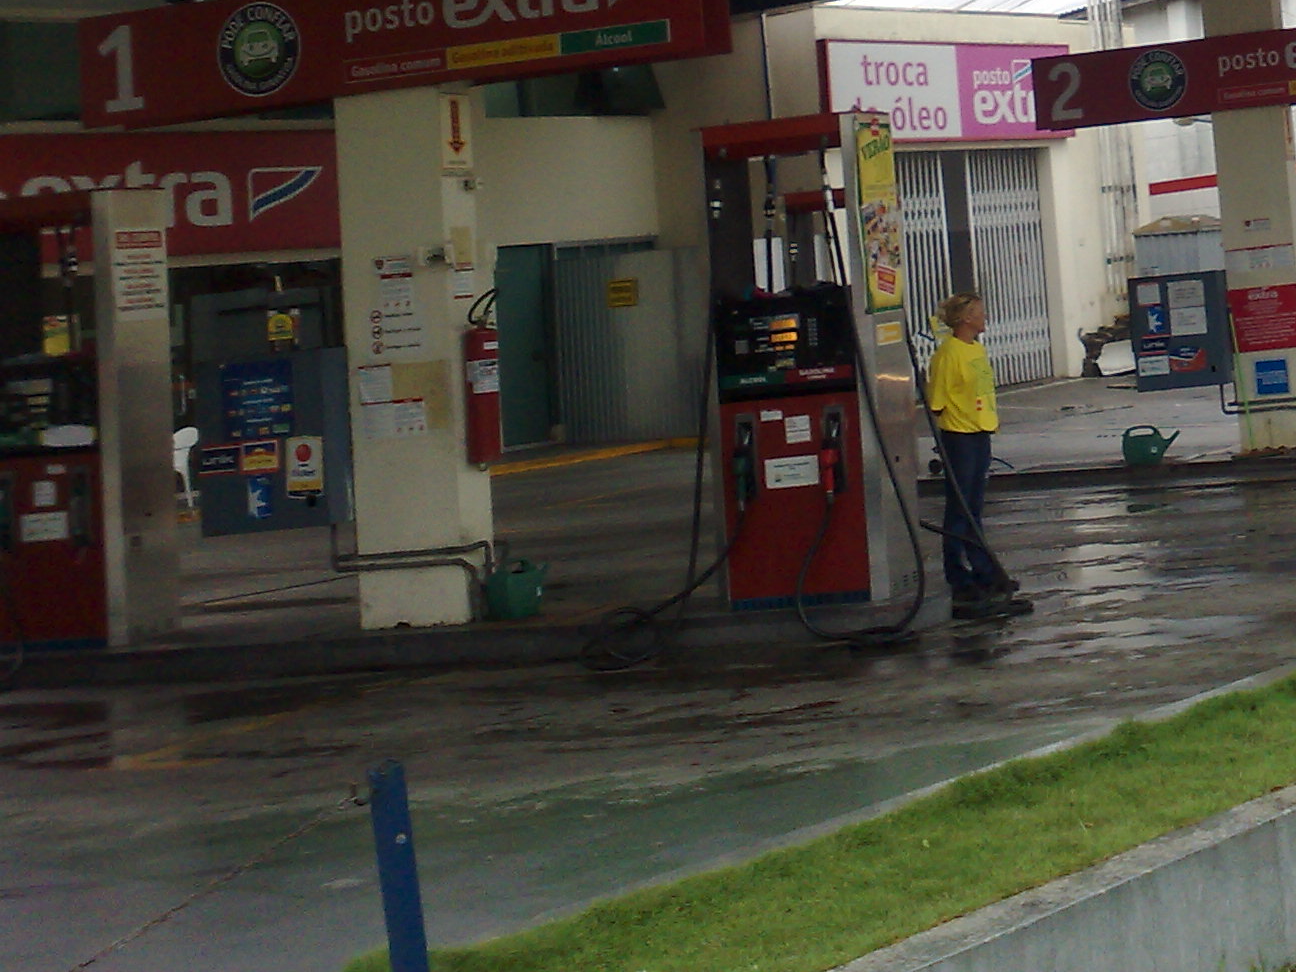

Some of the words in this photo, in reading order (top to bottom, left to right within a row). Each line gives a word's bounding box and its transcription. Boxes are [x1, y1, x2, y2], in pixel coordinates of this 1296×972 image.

[98, 25, 145, 114] 1
[861, 55, 929, 88] troca
[973, 67, 1011, 90] posto
[1217, 47, 1280, 77] posto
[974, 83, 1037, 125] extr
[1047, 62, 1085, 123] 2
[892, 97, 948, 132] óleo
